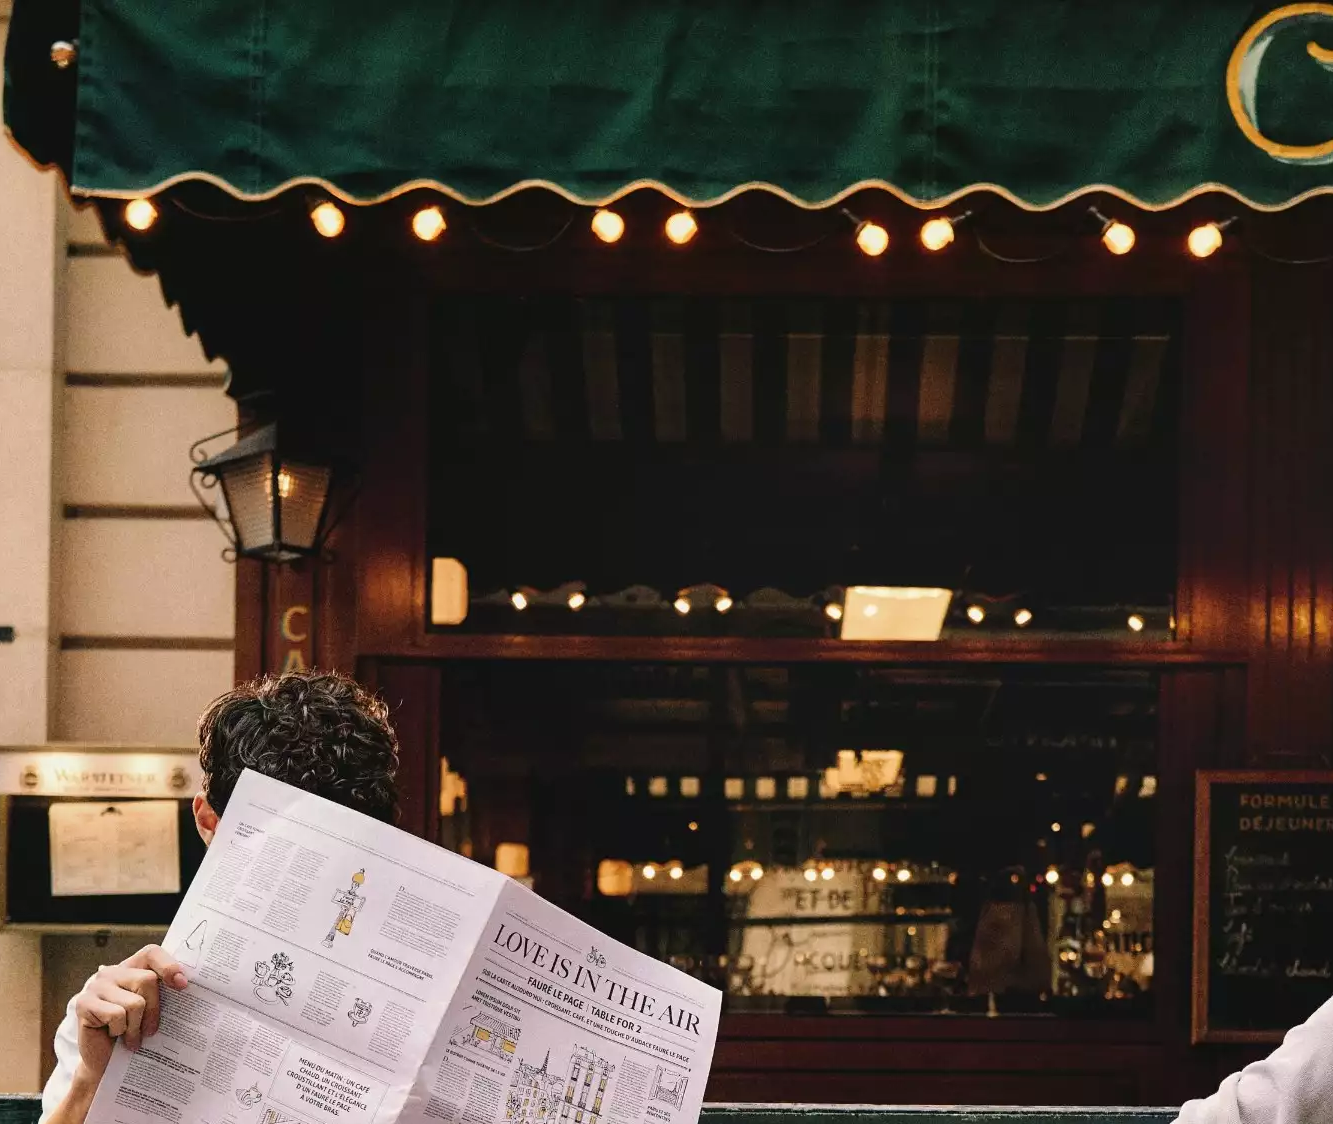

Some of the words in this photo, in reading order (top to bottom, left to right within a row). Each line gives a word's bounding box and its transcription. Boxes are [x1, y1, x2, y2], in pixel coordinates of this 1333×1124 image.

[1240, 794, 1331, 809] FORMULE
[492, 923, 551, 968] LOVE
[546, 953, 573, 979] IS
[571, 965, 602, 993] IN
[598, 978, 660, 1017] THE
[657, 1002, 706, 1035] AIR
[526, 976, 553, 994] FAURÉ
[552, 988, 563, 999] LE
[562, 993, 585, 1009] PAGE
[589, 1005, 616, 1023] TABLE
[615, 1017, 635, 1030] FOR
[286, 1069, 327, 1092] CROUSTILLANT
[334, 1091, 367, 1110] L'ÉLÉGANCE
[298, 1057, 315, 1069] MENU
[314, 1064, 325, 1073] DU
[324, 1069, 343, 1081] MATIN
[345, 1078, 355, 1086] UN
[354, 1082, 370, 1093] CAFÉ
[298, 1066, 321, 1081] CHAUD,
[321, 1076, 330, 1084] UN
[329, 1080, 362, 1099] CROISSANT
[295, 1083, 310, 1093] D'UN
[310, 1089, 329, 1102] FAURÉ
[335, 1101, 351, 1112] PAGE
[305, 1096, 323, 1108] VOTRE
[323, 1104, 340, 1116] BRAS.
